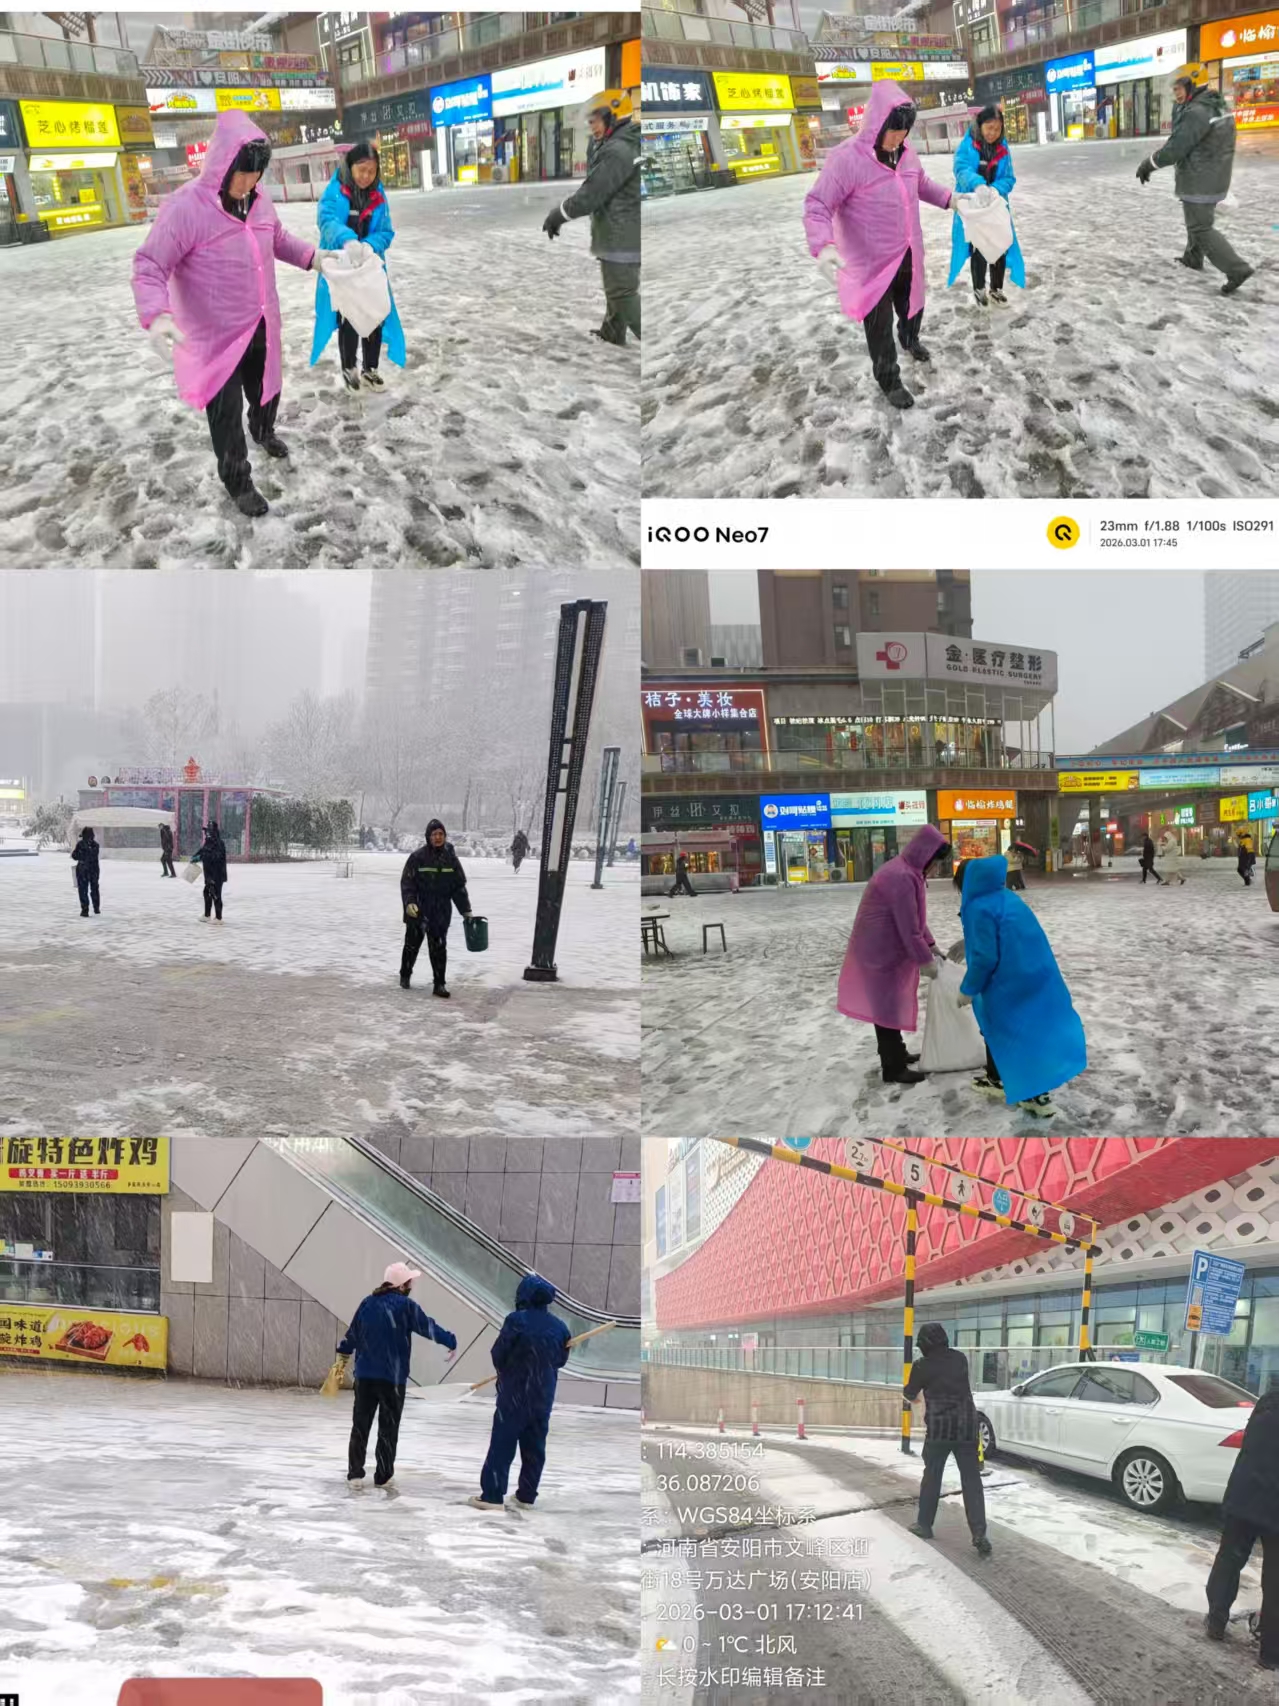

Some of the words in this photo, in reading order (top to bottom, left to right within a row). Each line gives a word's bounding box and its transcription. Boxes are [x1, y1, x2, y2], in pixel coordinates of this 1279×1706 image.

[37, 119, 109, 135] 芝心烤榴莲
[1008, 671, 1042, 681] SURGERY
[674, 708, 757, 720] 全球大牌小样集合店
[910, 1164, 920, 1182] 5
[1196, 1256, 1209, 1280] P
